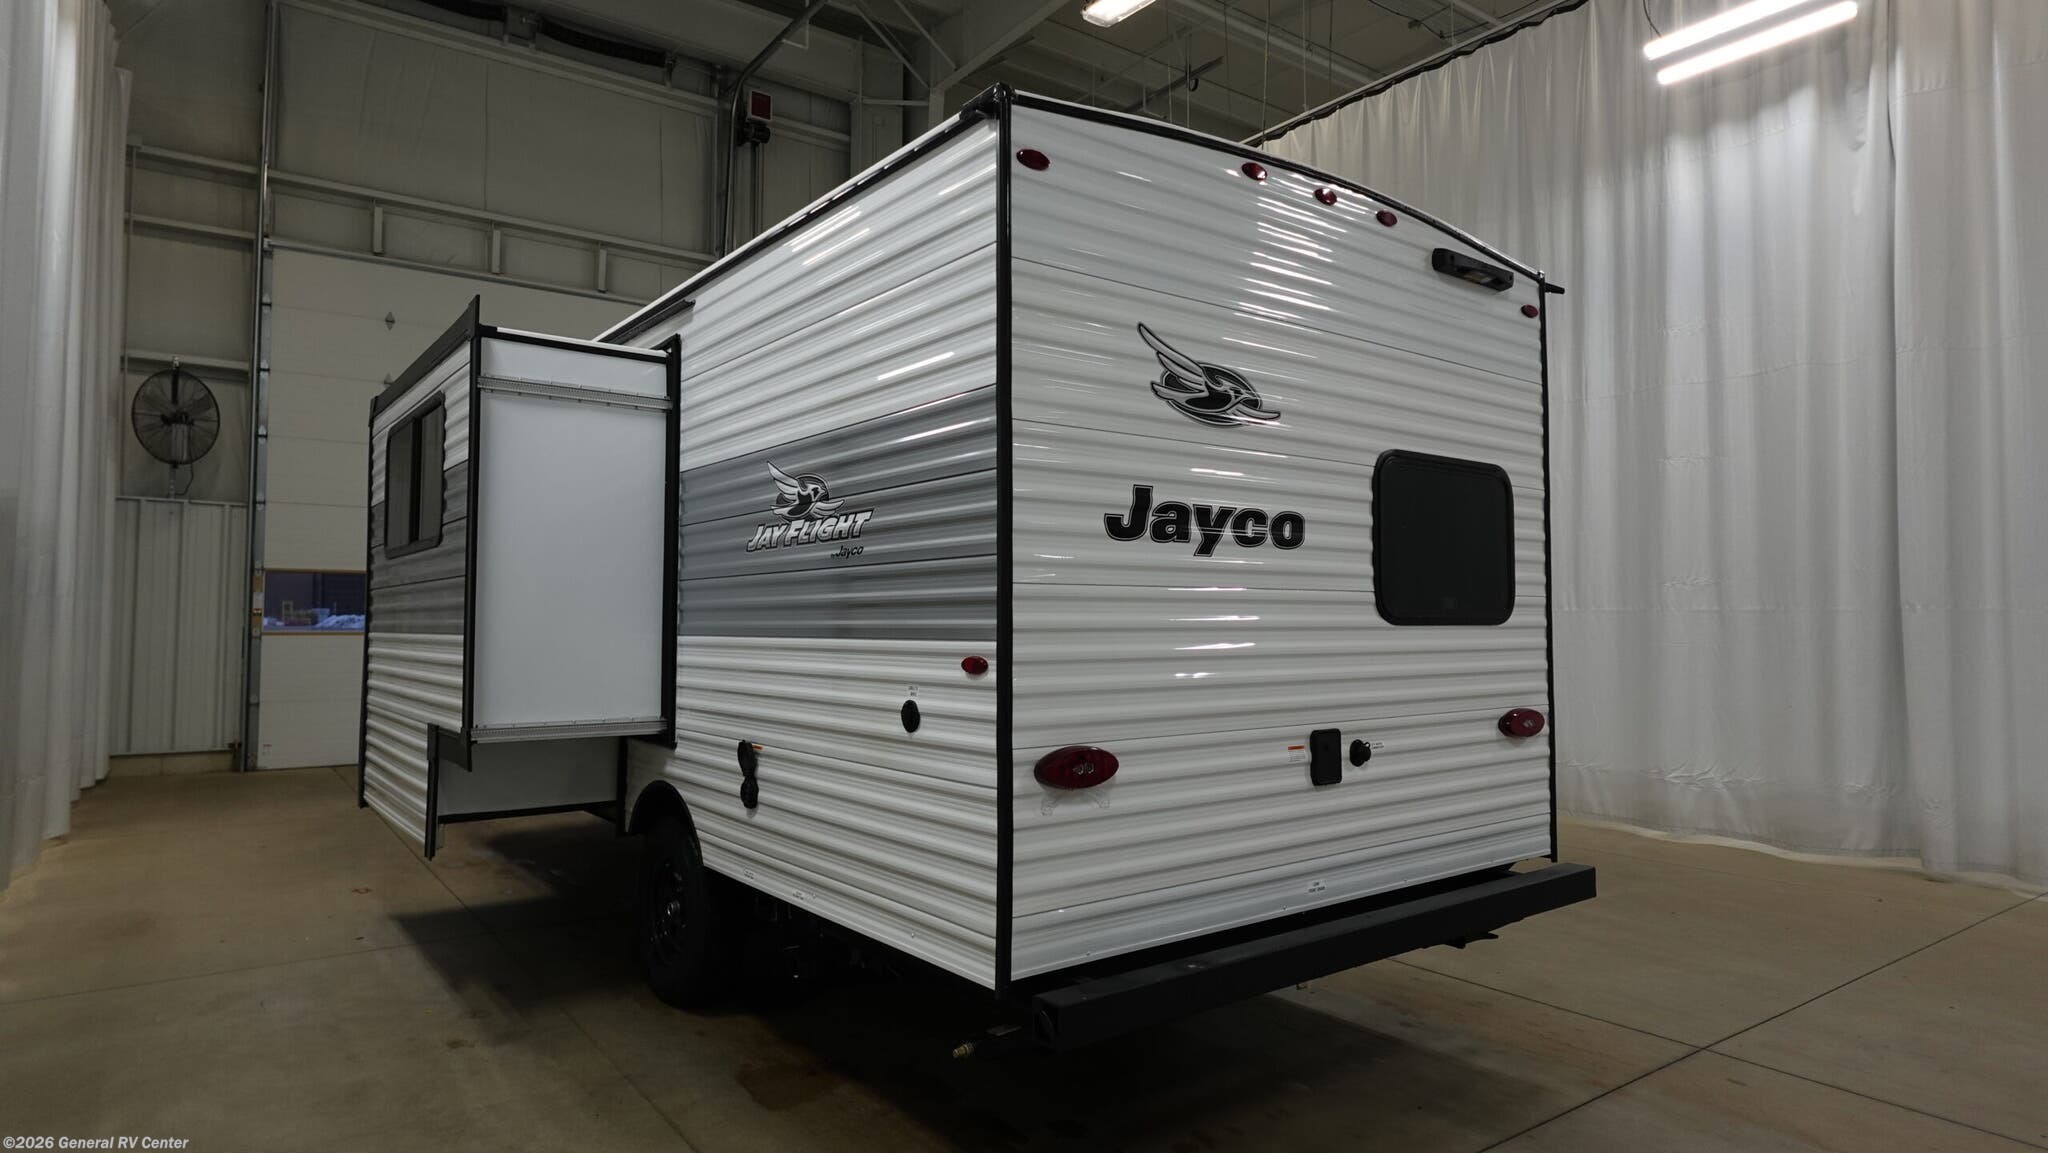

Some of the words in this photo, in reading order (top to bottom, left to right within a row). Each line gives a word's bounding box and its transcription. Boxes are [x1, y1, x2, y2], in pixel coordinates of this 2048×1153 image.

[746, 523, 788, 553] JAY
[783, 509, 874, 547] FLIGHT
[1104, 484, 1306, 558] Jayco
[836, 545, 864, 559] Jayco
